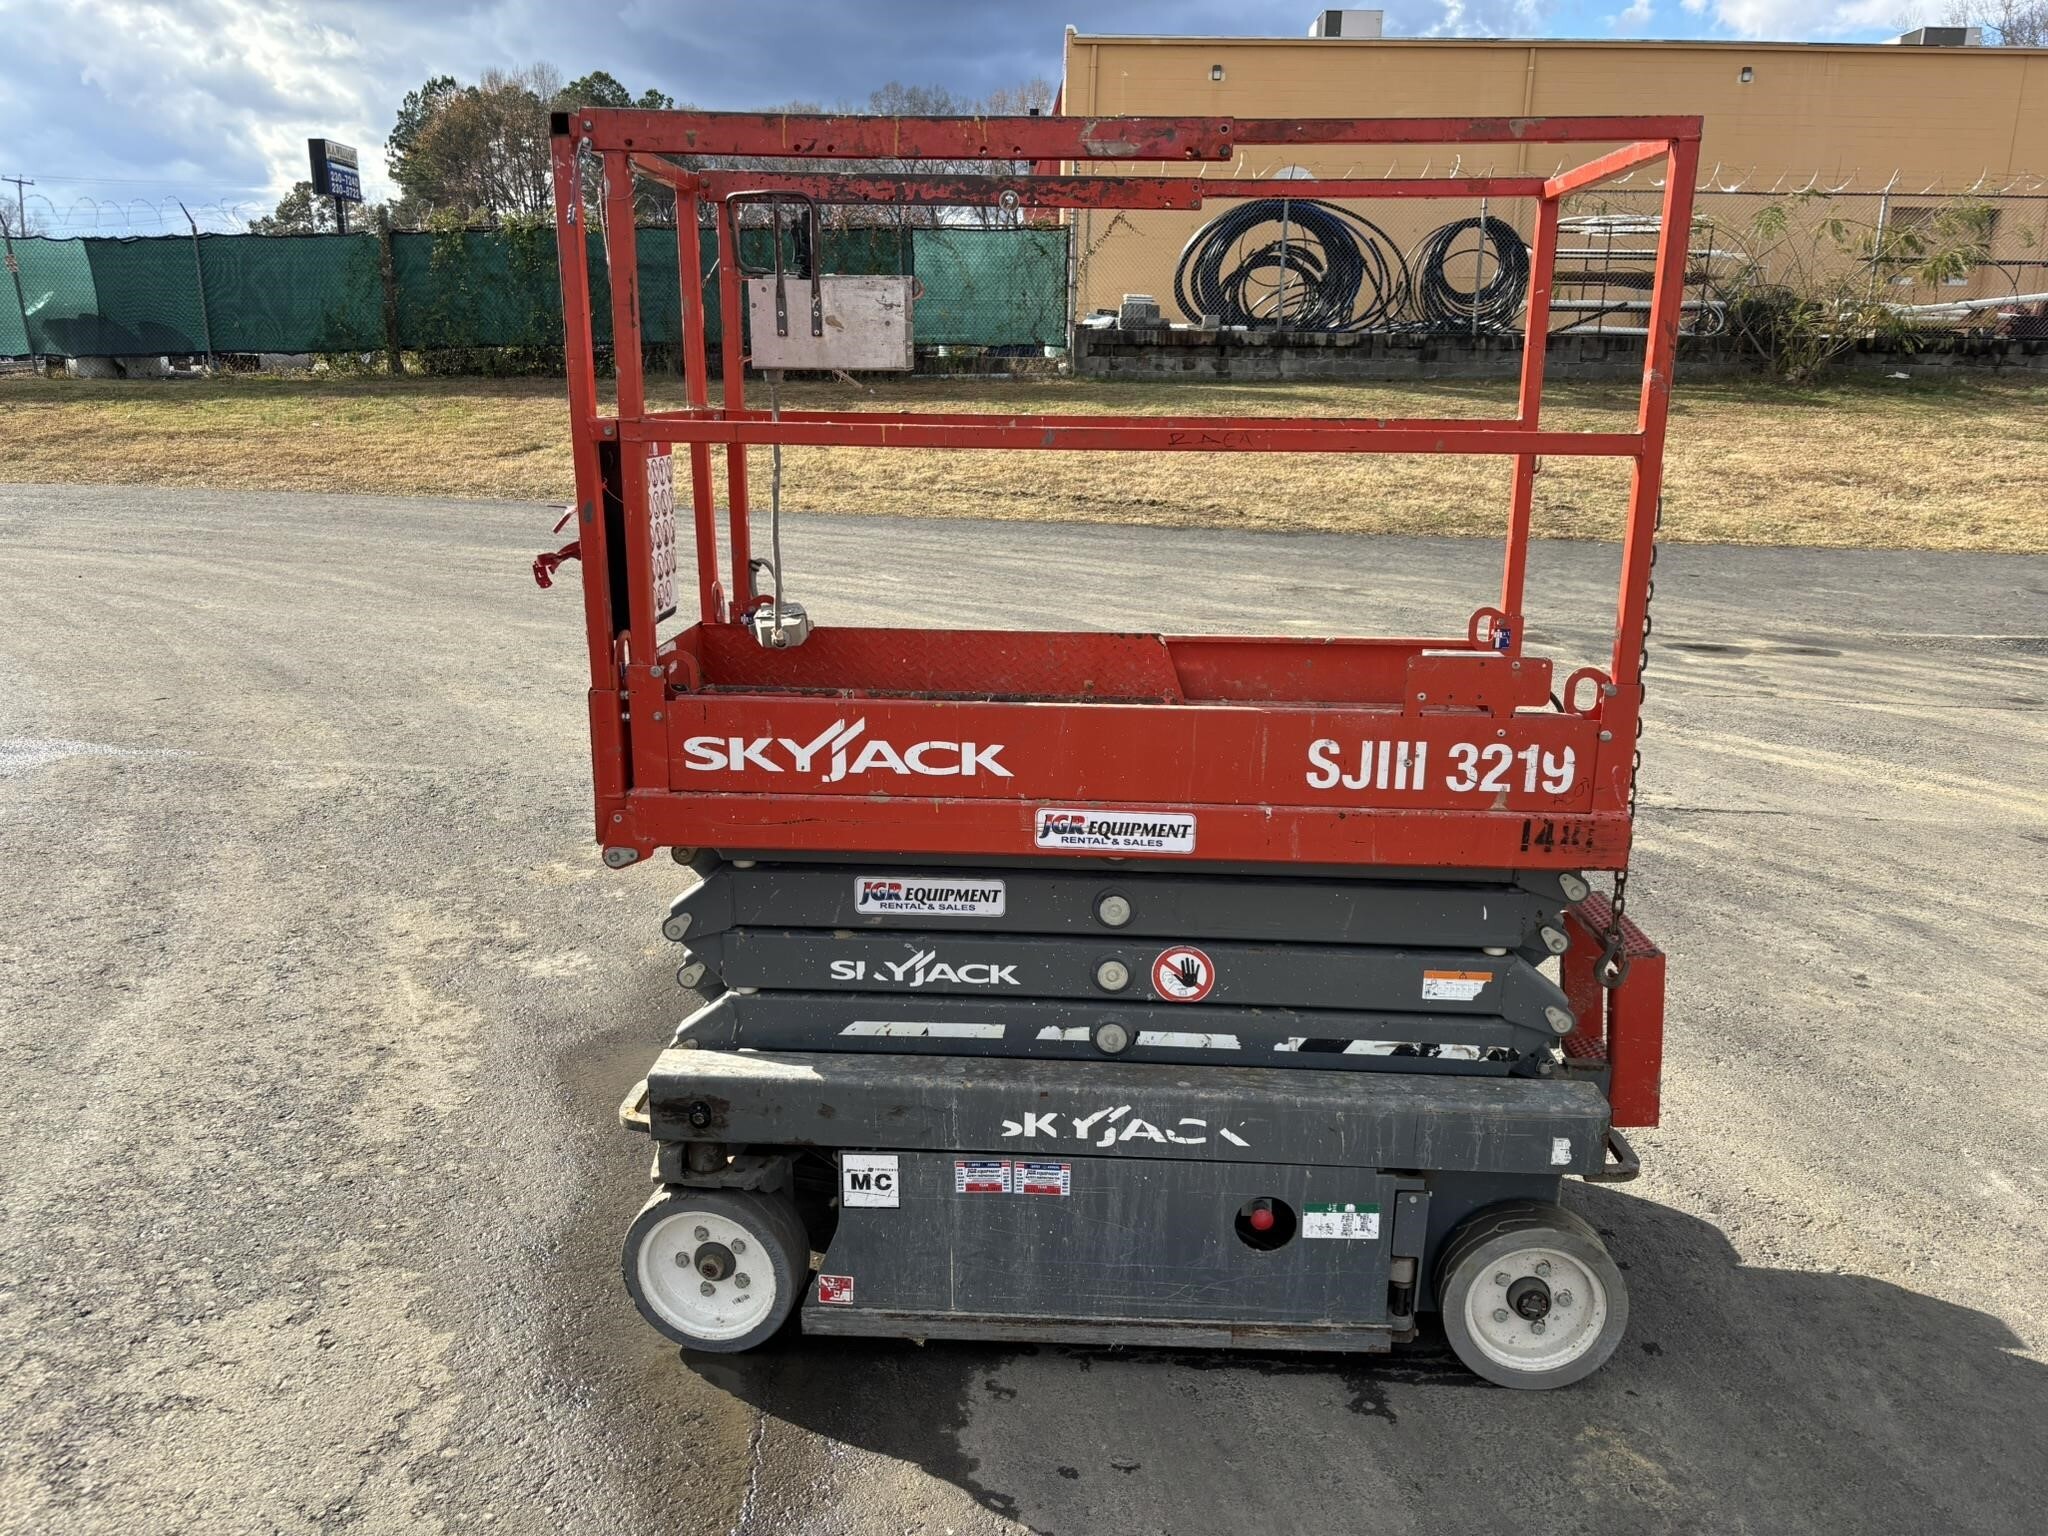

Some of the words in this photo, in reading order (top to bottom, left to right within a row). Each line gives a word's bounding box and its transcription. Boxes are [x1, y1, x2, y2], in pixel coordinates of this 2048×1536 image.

[683, 716, 1015, 783] SKYJACK
[1446, 743, 1575, 794] 3219
[1039, 813, 1086, 839] JGR
[1088, 821, 1192, 841] EQUIPMENT
[1061, 836, 1108, 845] RENTAL
[1111, 838, 1120, 846] &
[1124, 838, 1164, 847] SALES
[859, 881, 902, 905] JGR
[904, 887, 1002, 905] EQUIPMENT
[880, 902, 924, 910] RENTAL
[851, 1173, 892, 1191] MC
